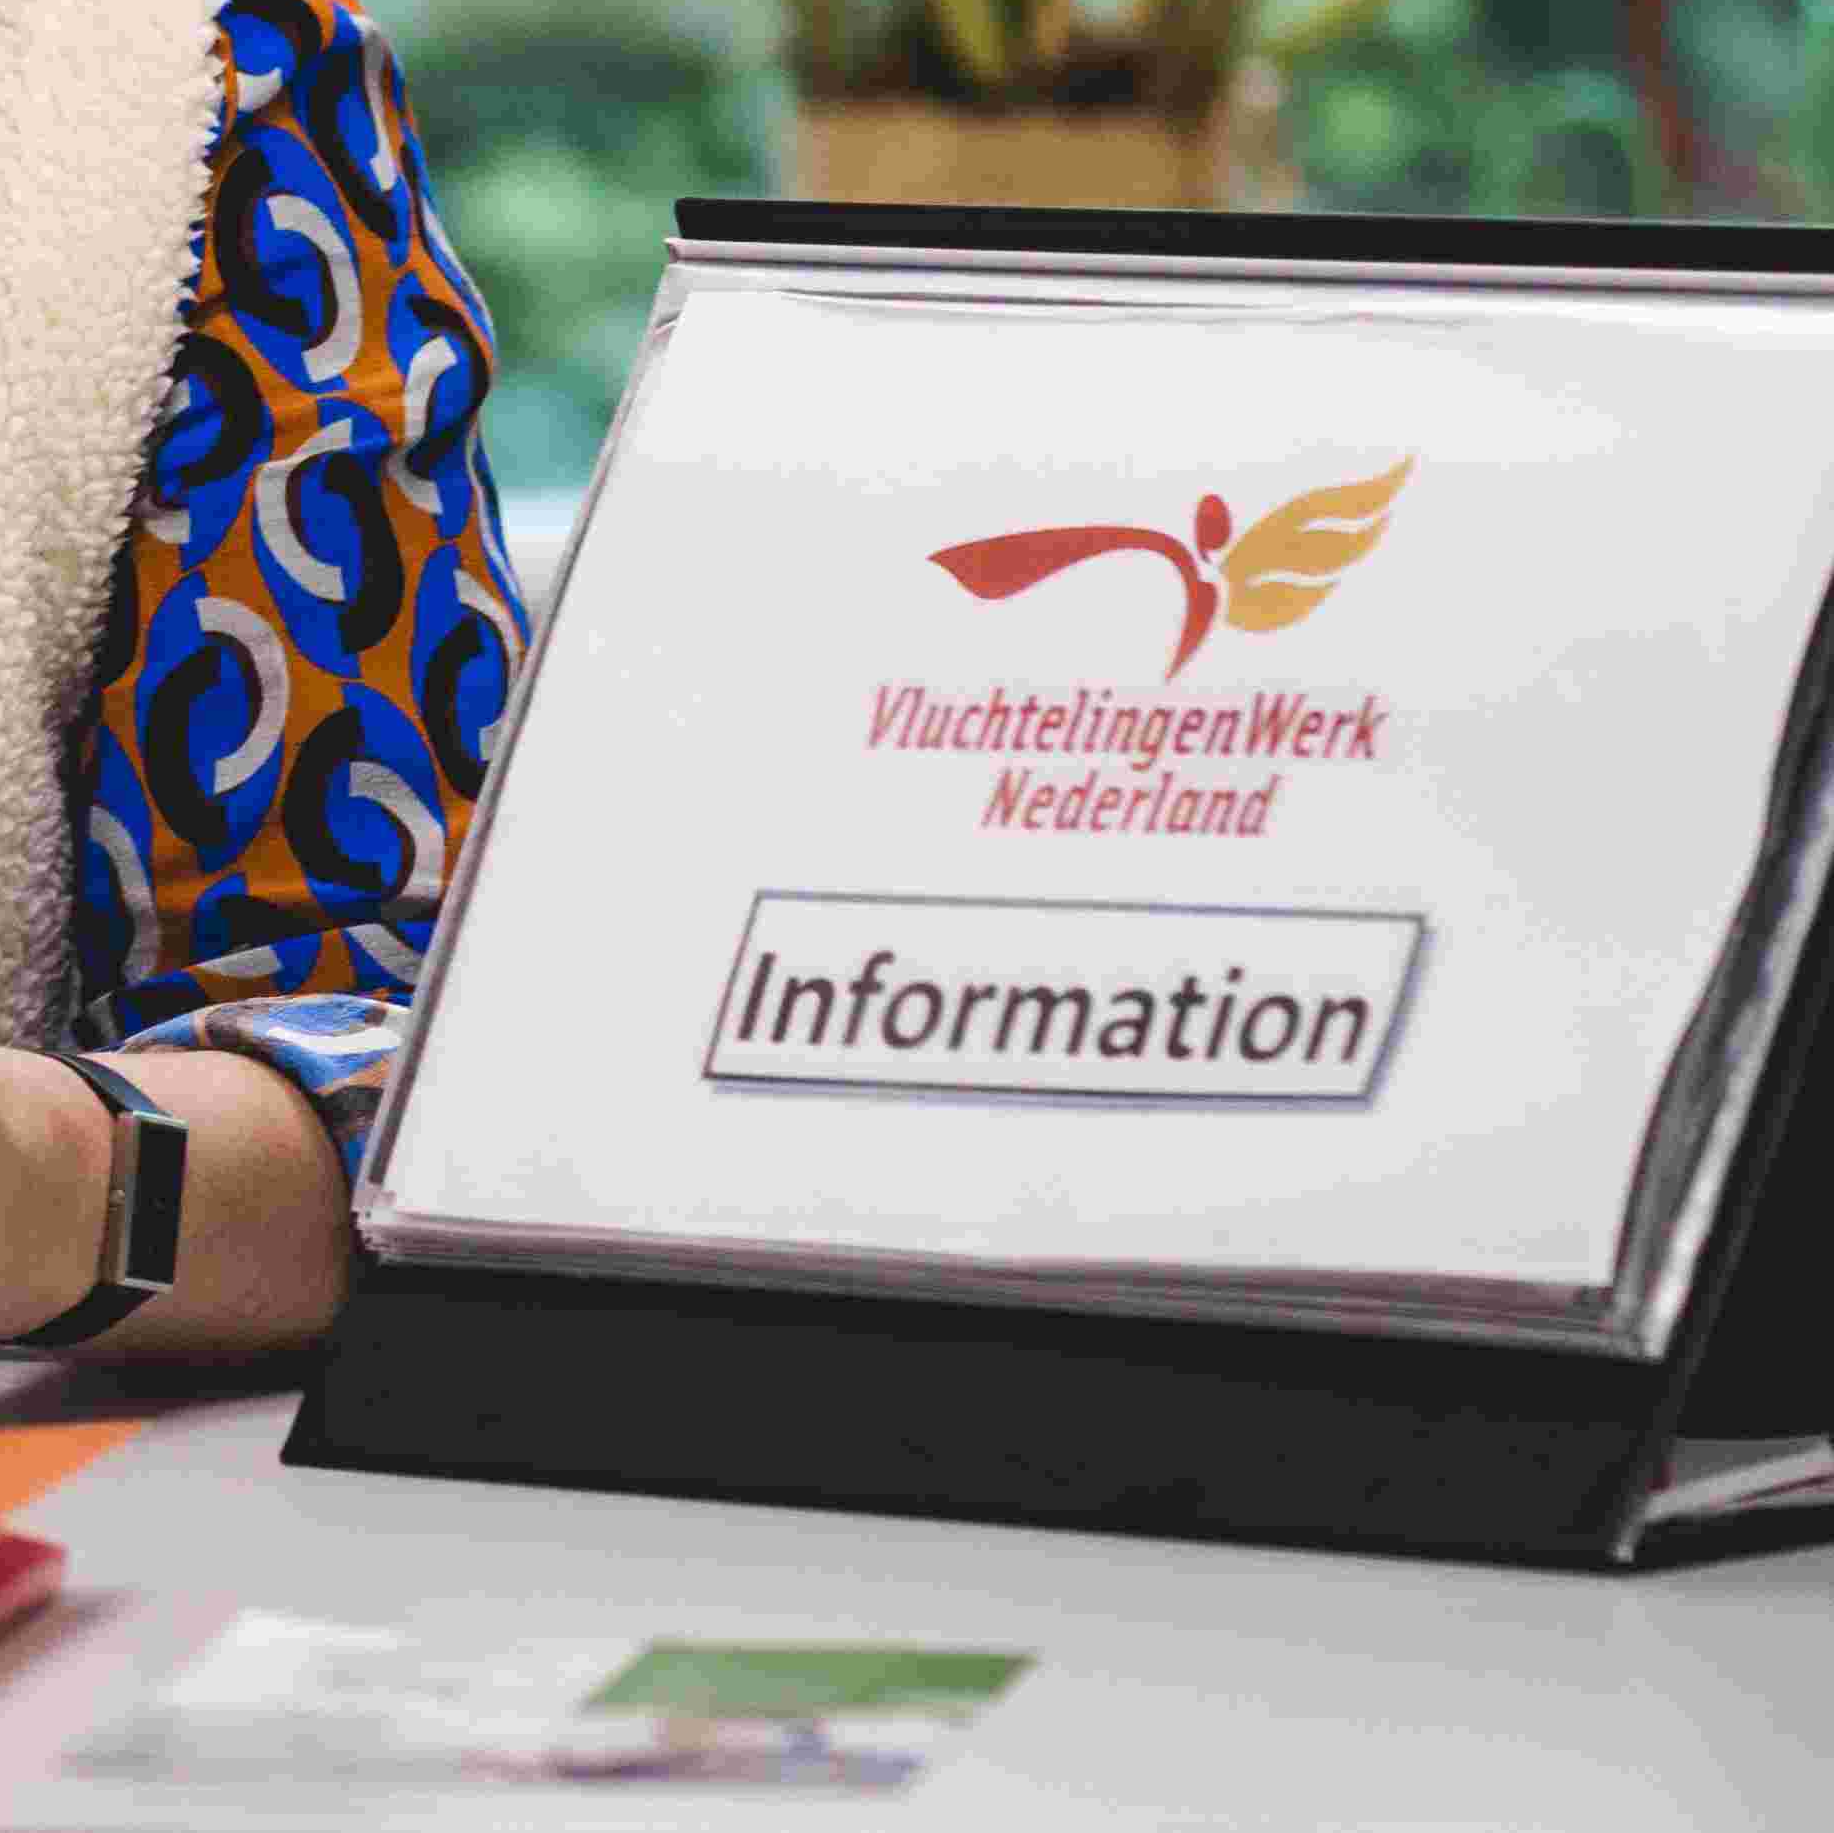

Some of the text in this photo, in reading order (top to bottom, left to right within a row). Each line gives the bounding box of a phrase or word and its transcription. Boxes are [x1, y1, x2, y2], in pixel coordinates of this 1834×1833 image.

[867, 686, 1388, 769] VluchtelingenWerk
[982, 768, 1278, 837] Nederland
[736, 951, 1371, 1064] Information
